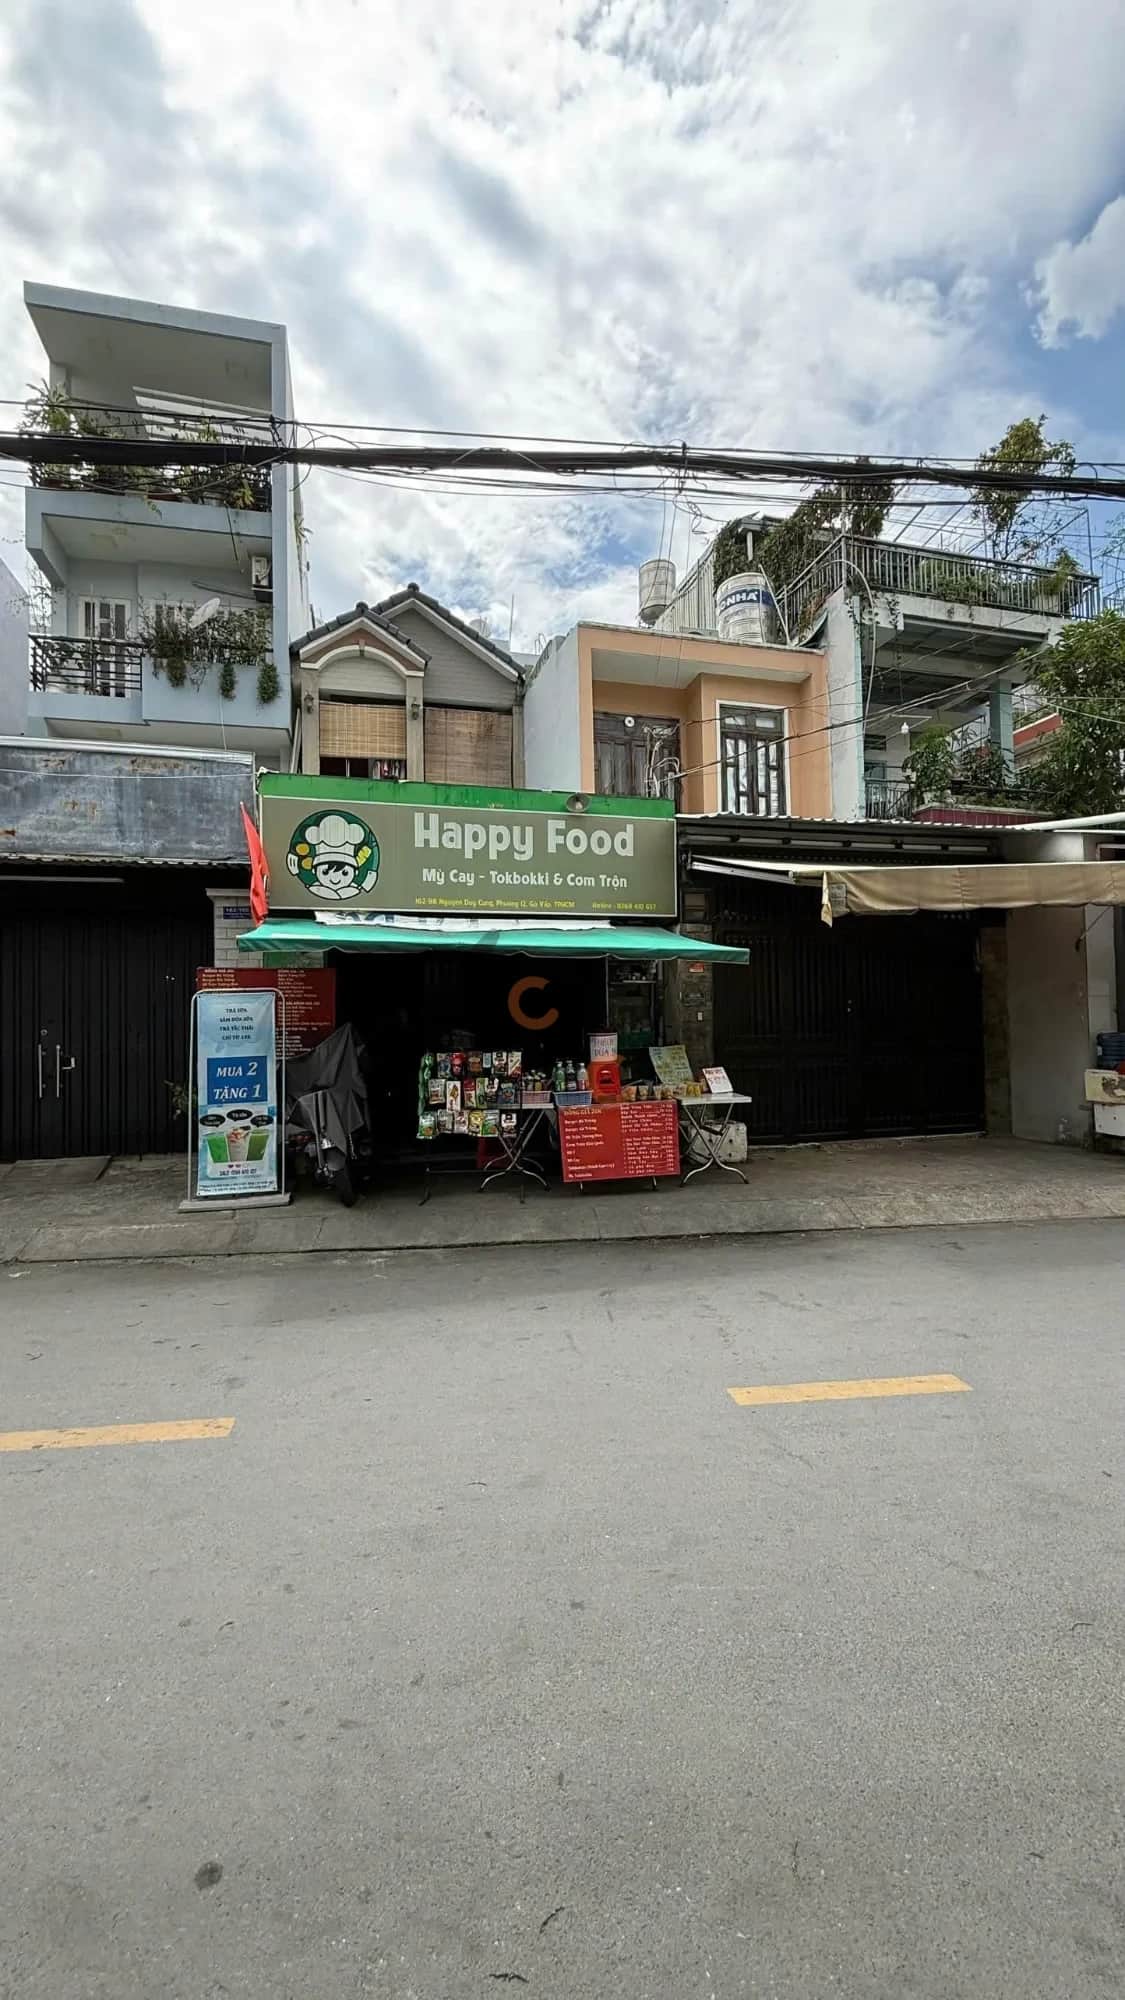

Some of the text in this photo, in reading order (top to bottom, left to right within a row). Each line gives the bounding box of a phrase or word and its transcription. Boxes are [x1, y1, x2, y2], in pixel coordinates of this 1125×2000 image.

[414, 812, 634, 861] Happy Food
[450, 869, 475, 886] Cay
[489, 870, 549, 886] Tokbokki
[553, 873, 563, 885] &
[600, 874, 627, 890] Trộn
[216, 1061, 258, 1077] MUA 2
[213, 1084, 261, 1102] TẶNG 1
